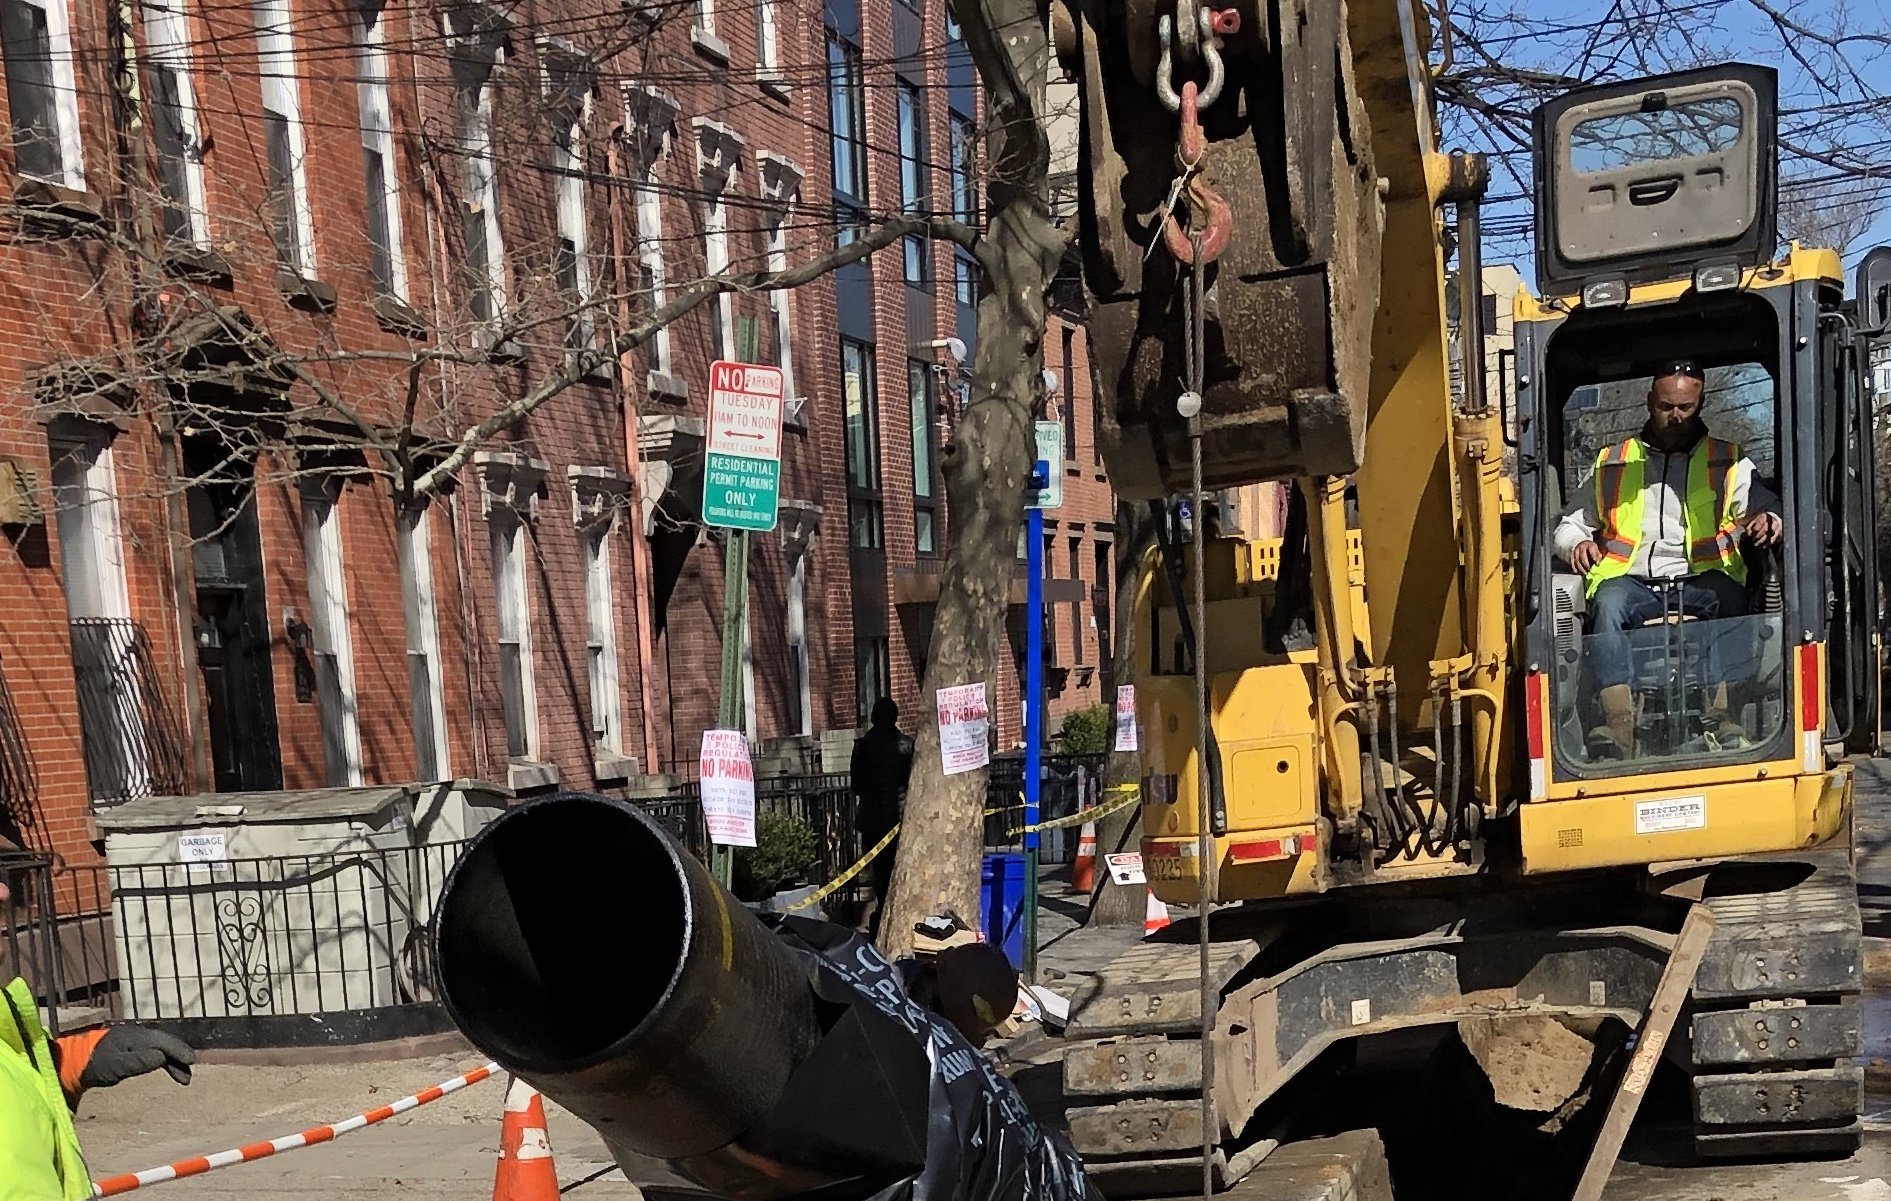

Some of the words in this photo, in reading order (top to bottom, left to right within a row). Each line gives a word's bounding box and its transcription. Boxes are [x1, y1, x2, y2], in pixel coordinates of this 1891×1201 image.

[717, 366, 744, 391] NO
[721, 393, 773, 410] TUESDAY
[737, 413, 748, 427] TO
[751, 415, 777, 430] NOON
[711, 457, 774, 476] RESIDENTIAL
[710, 472, 738, 486] PERMIT
[740, 475, 774, 491] PARKING
[725, 490, 757, 507] ONLY
[701, 758, 714, 778] NO
[1640, 803, 1700, 816] BINDER
[181, 836, 223, 847] GARBAGE
[192, 848, 214, 857] ONLY
